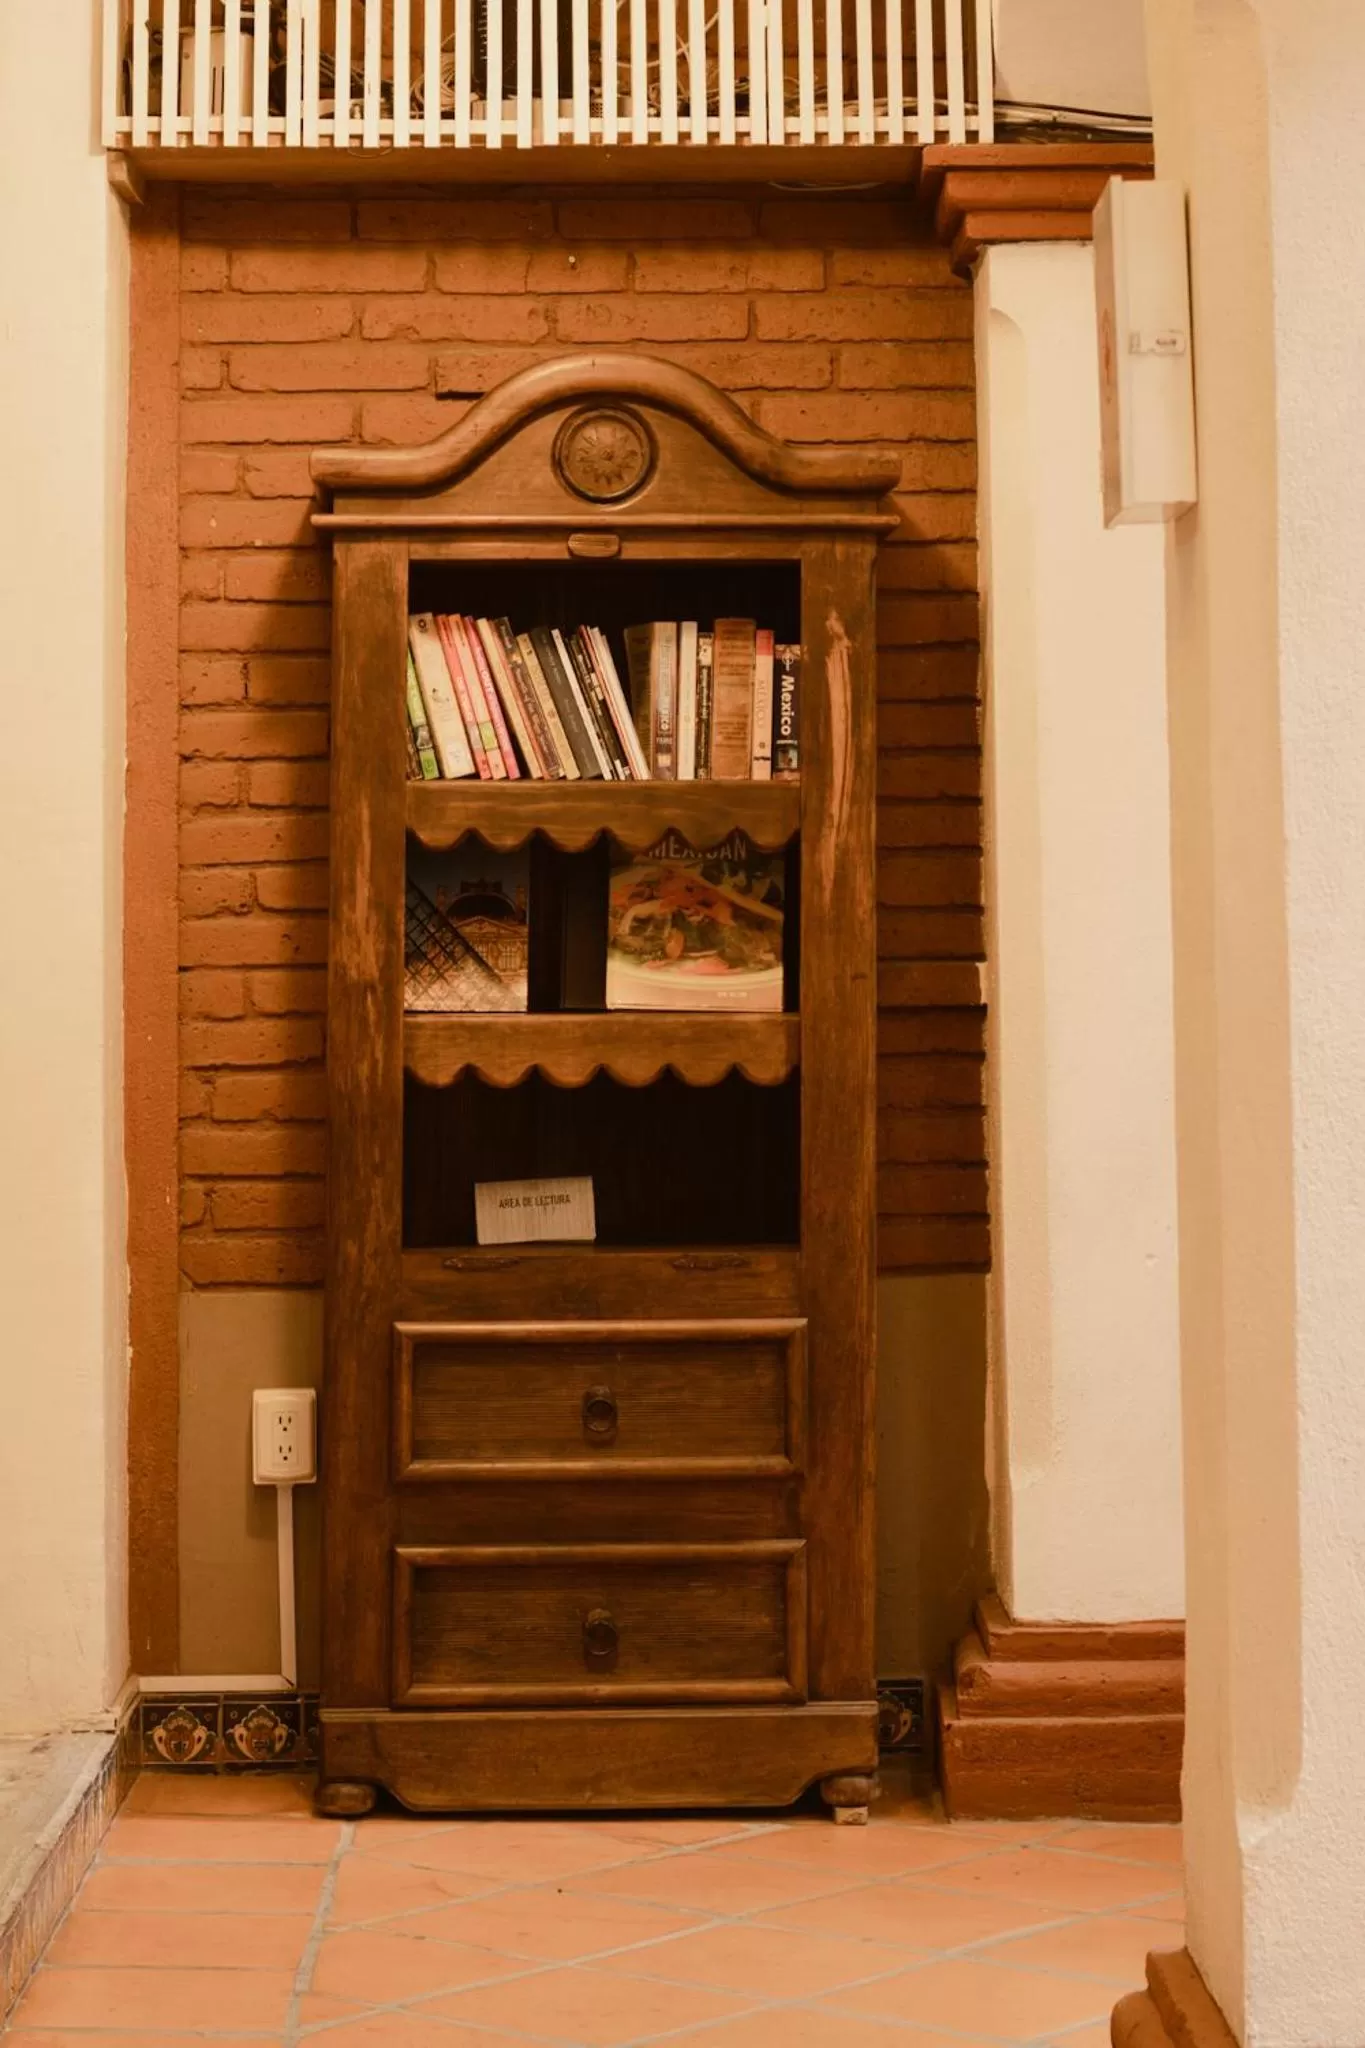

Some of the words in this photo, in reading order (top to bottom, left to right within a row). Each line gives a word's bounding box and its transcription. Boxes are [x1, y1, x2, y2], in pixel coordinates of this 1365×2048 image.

[779, 674, 794, 735] Mexico
[648, 834, 747, 861] MEAN
[522, 1196, 533, 1208] DE
[534, 1194, 571, 1207] LECTURA
